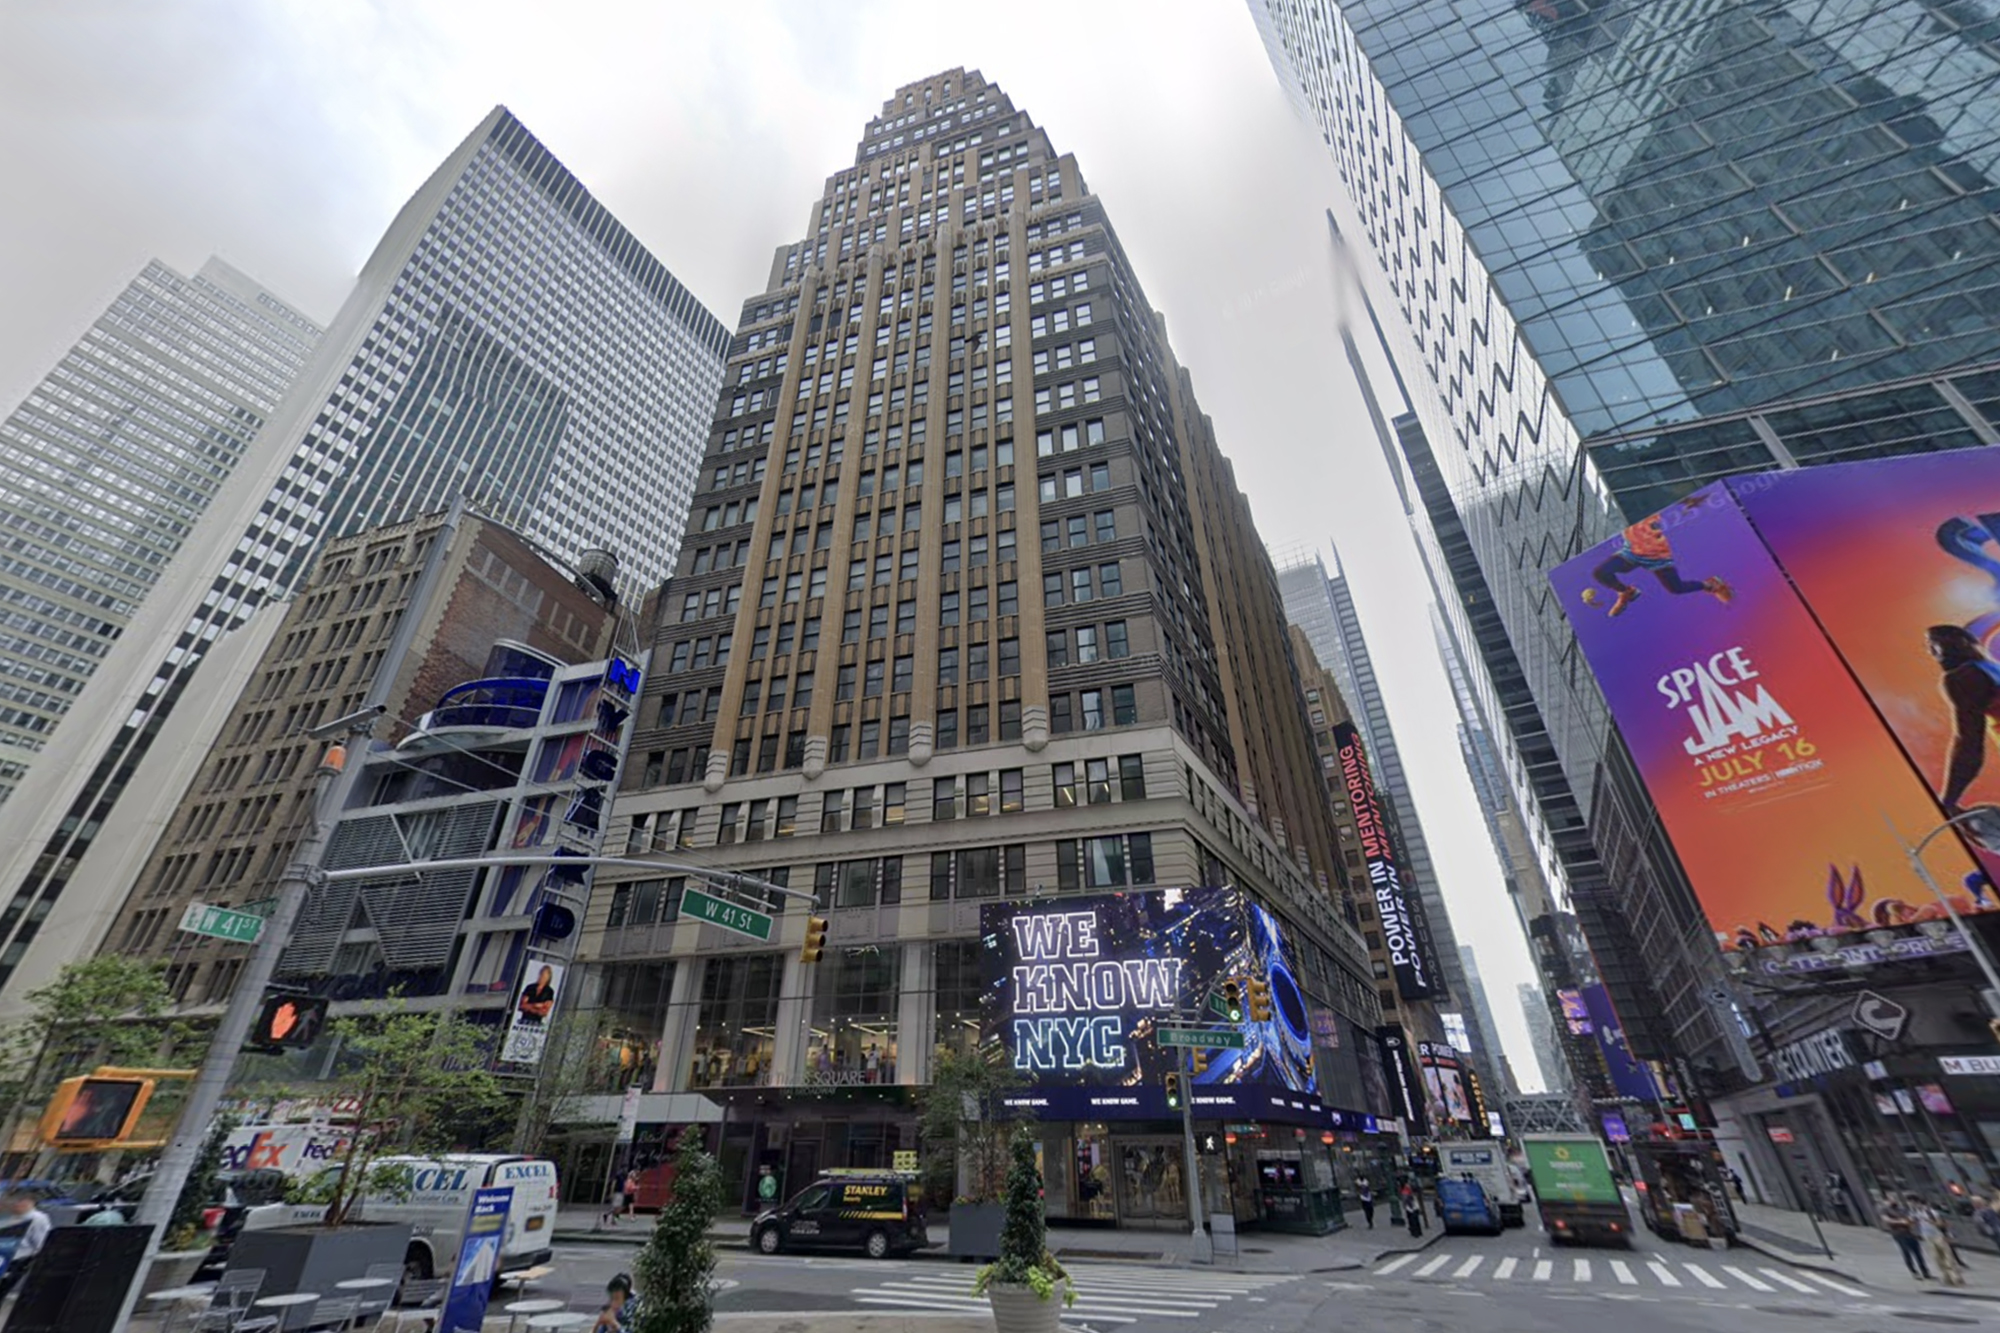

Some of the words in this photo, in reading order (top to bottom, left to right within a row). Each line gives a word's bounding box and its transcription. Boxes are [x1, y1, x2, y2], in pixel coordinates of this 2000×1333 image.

[1656, 646, 1760, 709] SPACE
[1683, 662, 1795, 756] JAM
[1700, 750, 1764, 787] JULY
[1777, 737, 1817, 760] 16
[1707, 745, 1737, 762] NEW
[1741, 725, 1799, 751] LEGACY
[1340, 745, 1381, 858] MENTORING
[1350, 733, 1393, 860] MENTORING
[1717, 774, 1772, 794] THEATERS
[1369, 860, 1386, 885] IN
[1386, 864, 1401, 890] IN
[201, 909, 221, 931] W
[706, 900, 719, 918] W
[722, 907, 736, 925] 41
[738, 913, 752, 930] St
[1376, 889, 1410, 966] POWER
[1012, 911, 1100, 960] WE
[1397, 898, 1427, 988] POWER
[1410, 899, 1441, 991] SQUARE
[1892, 933, 1968, 956] PRIE
[1013, 958, 1182, 1013] KNOW
[1014, 1015, 1126, 1069] NYC
[1169, 1032, 1232, 1047] Broadway
[1784, 1027, 1854, 1080] COUNTER
[813, 1070, 866, 1086] SQUARE
[1943, 1060, 1964, 1072] M
[1003, 1098, 1013, 1106] WE
[1014, 1098, 1030, 1106] KNOW
[221, 1130, 289, 1171] edEx
[302, 1137, 349, 1161] FedE
[402, 1166, 468, 1192] XCEL
[505, 1154, 550, 1179] EXCEL
[843, 1185, 888, 1197] STANLEY
[474, 1204, 495, 1214] Back
[478, 1194, 510, 1205] Welcome
